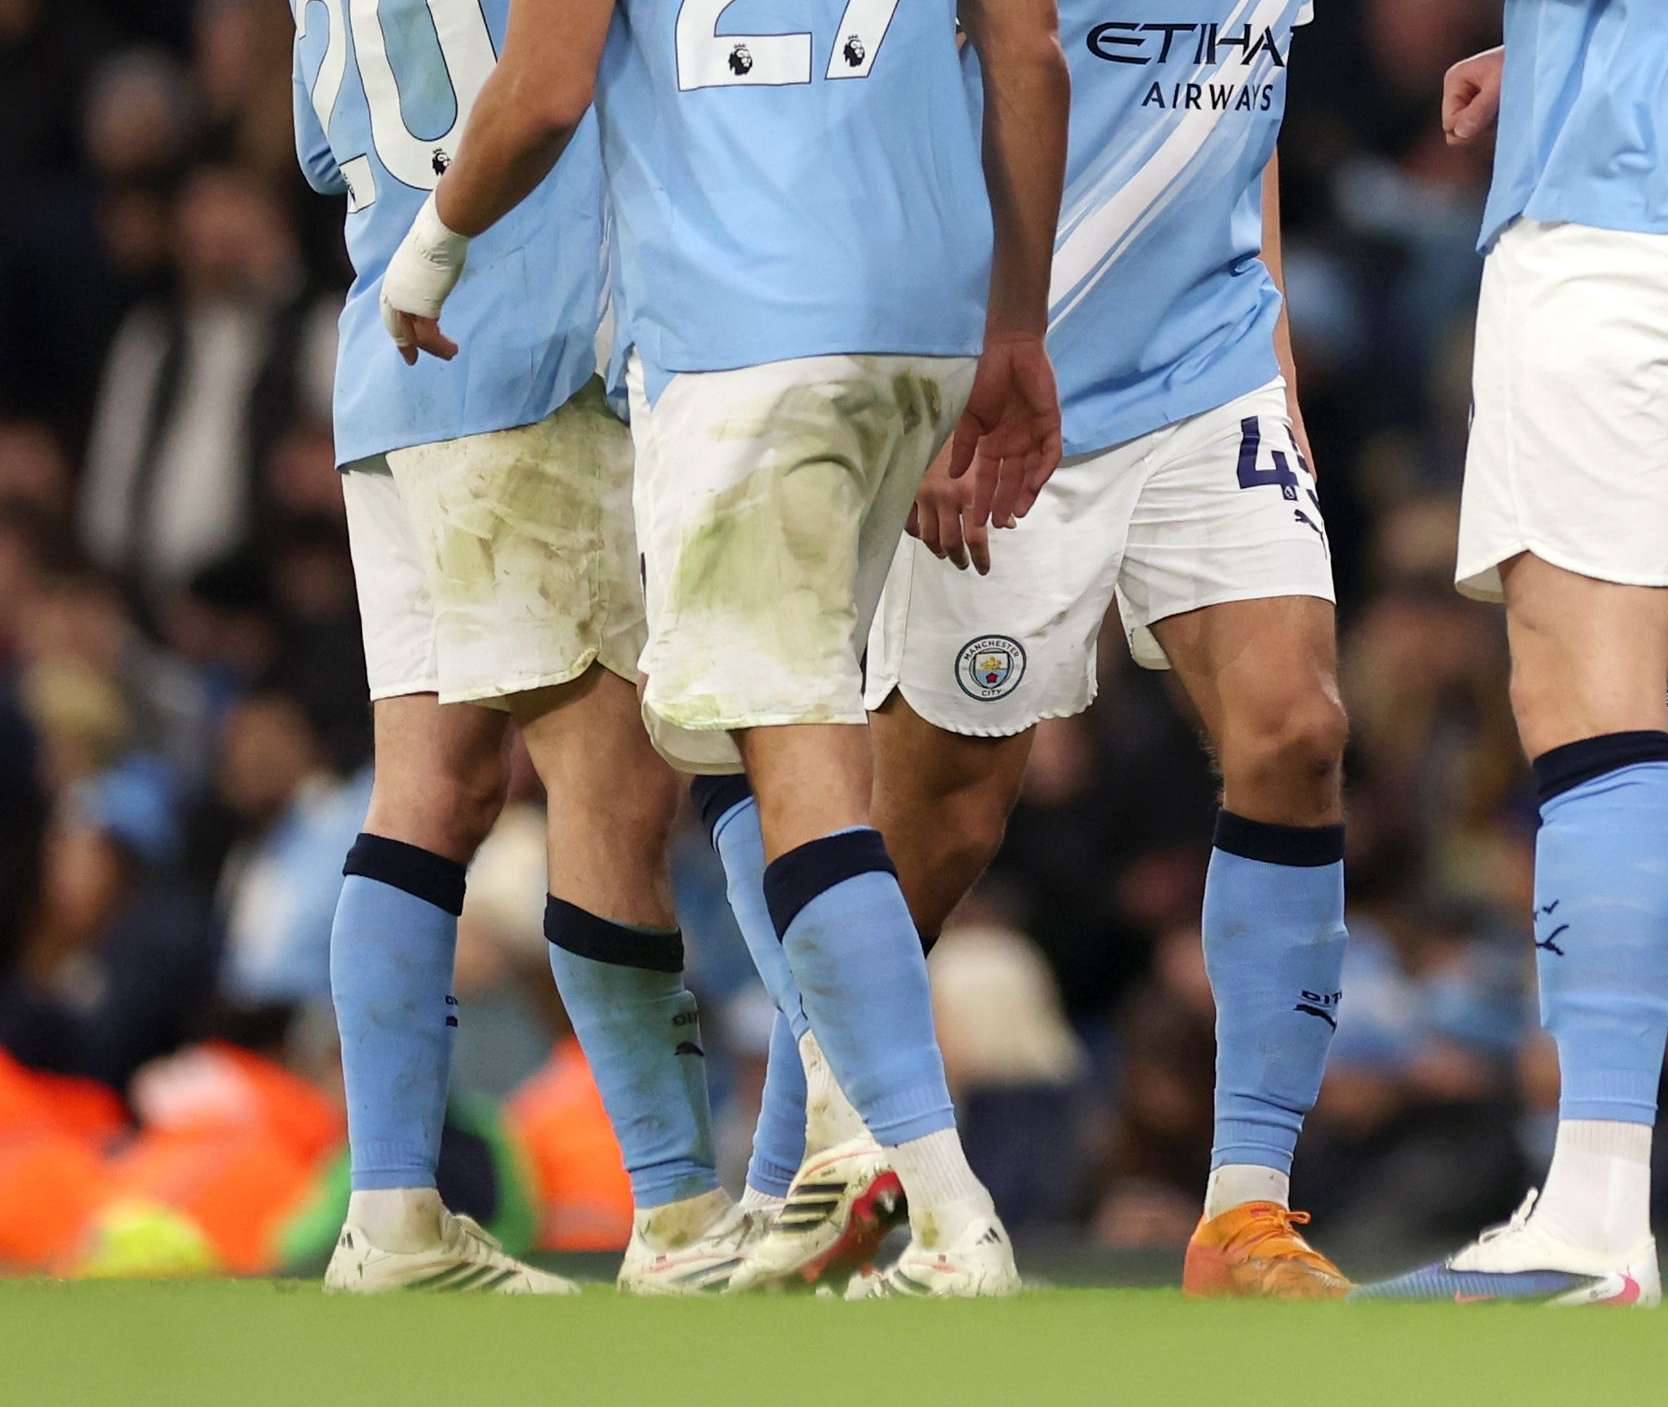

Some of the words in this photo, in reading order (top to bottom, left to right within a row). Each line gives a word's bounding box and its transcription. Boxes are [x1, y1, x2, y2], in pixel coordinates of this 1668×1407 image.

[1086, 22, 1294, 68] ETIHA
[1141, 81, 1274, 112] AIRWAYS
[963, 640, 1020, 661] MANCHESTER
[981, 689, 1002, 697] CITY
